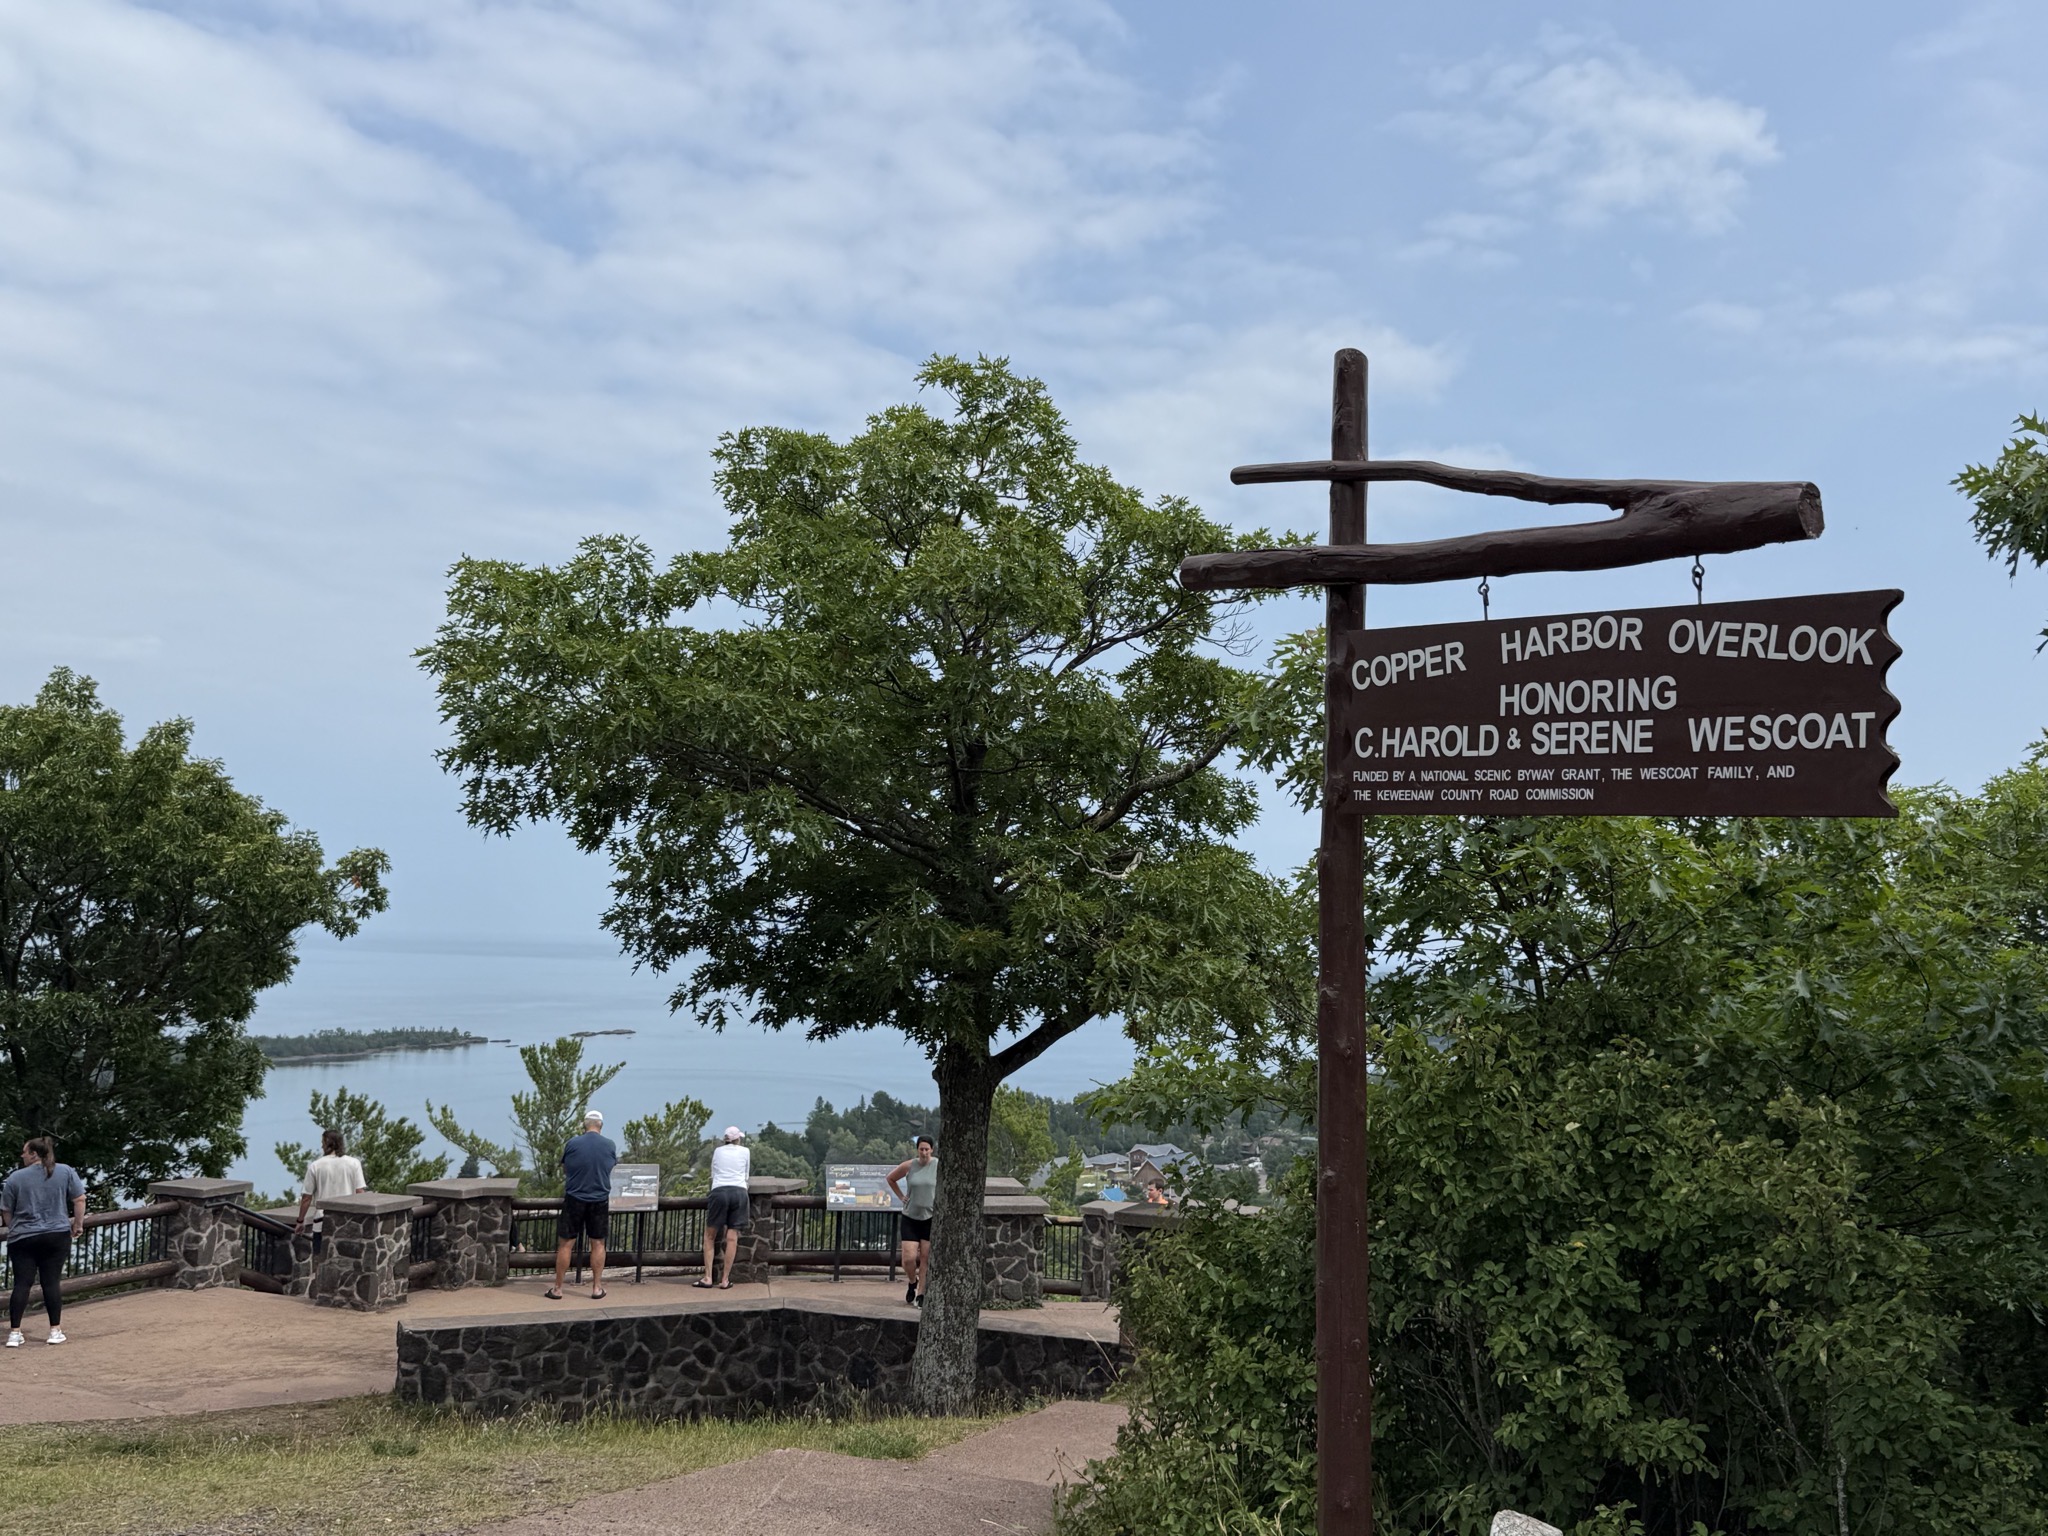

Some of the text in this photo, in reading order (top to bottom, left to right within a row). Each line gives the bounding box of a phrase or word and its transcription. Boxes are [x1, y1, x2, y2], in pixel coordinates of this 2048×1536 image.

[1352, 616, 1876, 690] COPPER HARBOR OVERLOOK
[1500, 676, 1677, 716] HONORING
[1507, 728, 1521, 750] &
[1531, 719, 1654, 755] SERENE
[1688, 712, 1876, 752] WESCOAT
[1353, 765, 1795, 783] FUNDED BY A NATIONAL SCENIC BYWAY GRANT, THE WESCOAT FAMILY, AND
[1354, 788, 1594, 801] THE KEWEENAW COUNTY ROAD COMMISSION
